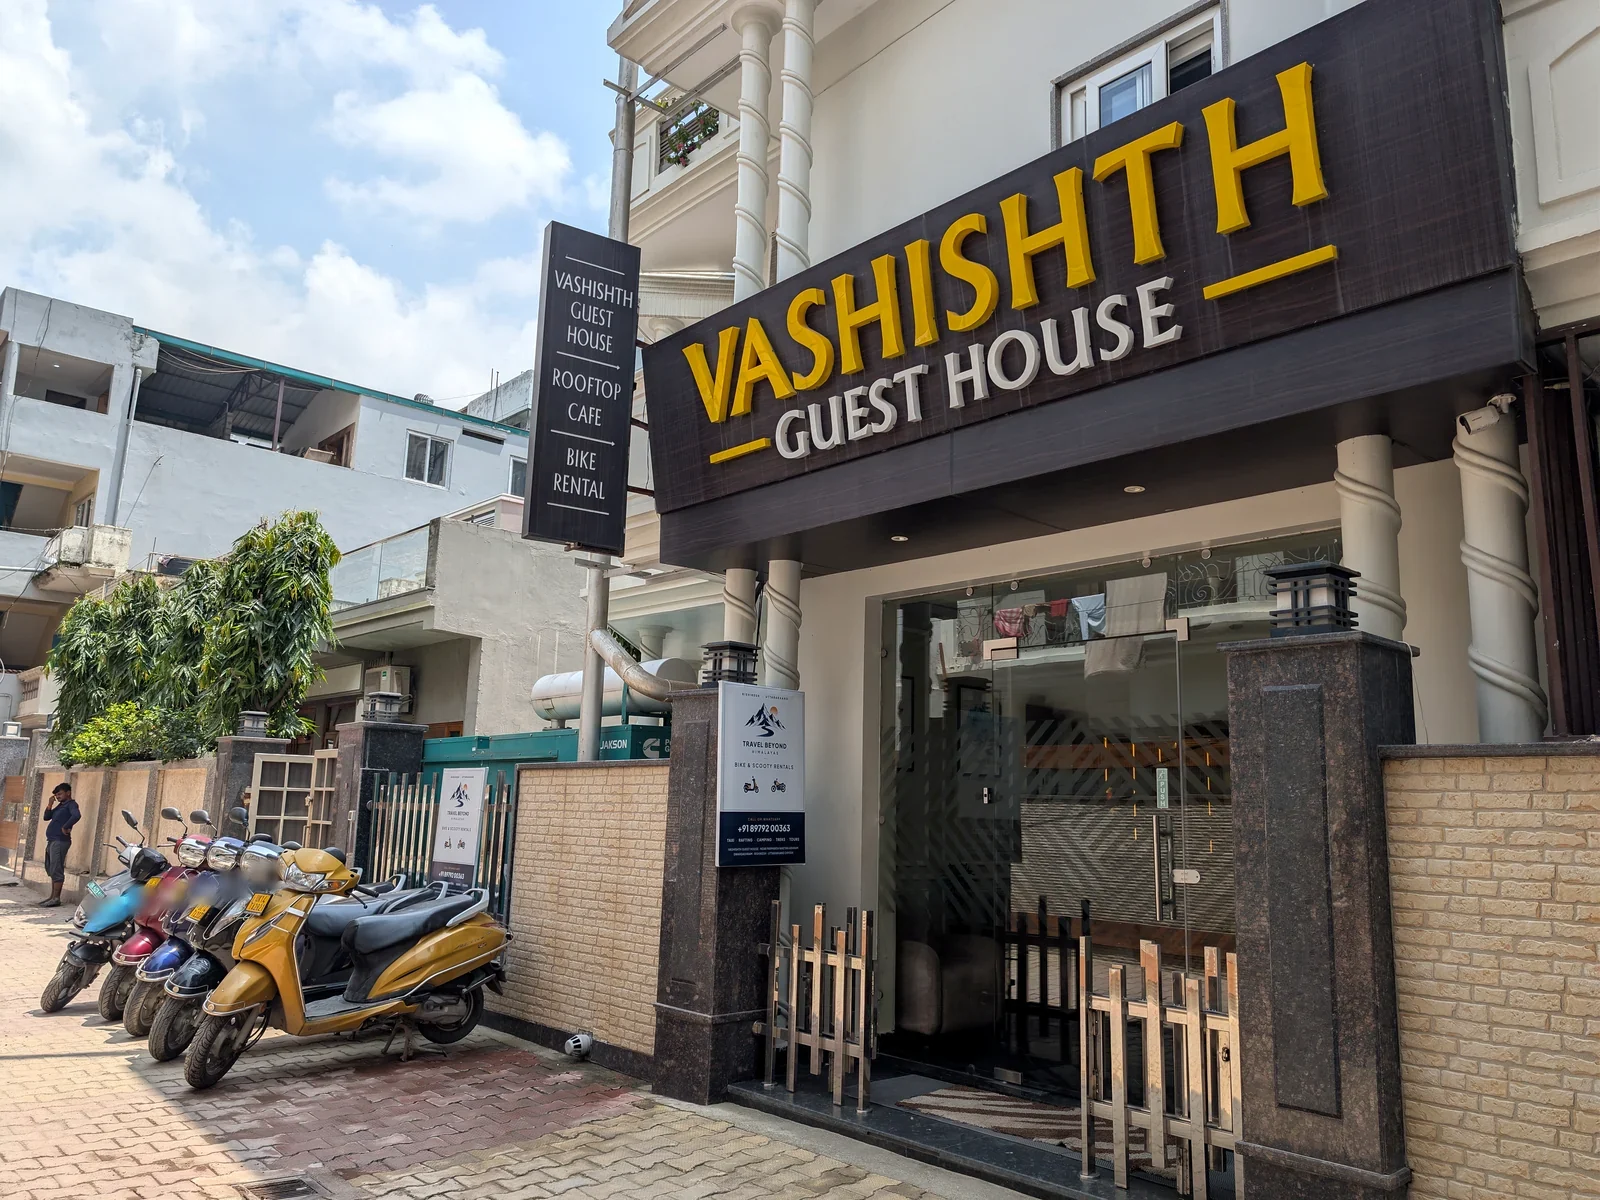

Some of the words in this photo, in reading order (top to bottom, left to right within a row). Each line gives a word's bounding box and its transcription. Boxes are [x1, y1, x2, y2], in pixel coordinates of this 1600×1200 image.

[682, 61, 1329, 424] VASHISHTH
[554, 269, 634, 309] VASHISHTH
[570, 301, 614, 328] GUEST
[567, 325, 613, 353] HOUSE
[775, 363, 929, 460] GUEST
[944, 276, 1184, 409] HOUSE
[552, 368, 622, 401] ROOFTOP
[568, 402, 602, 427] CAFE
[566, 448, 596, 471] BIKE
[553, 473, 605, 500] RENTAL
[600, 739, 628, 750] JAKSON
